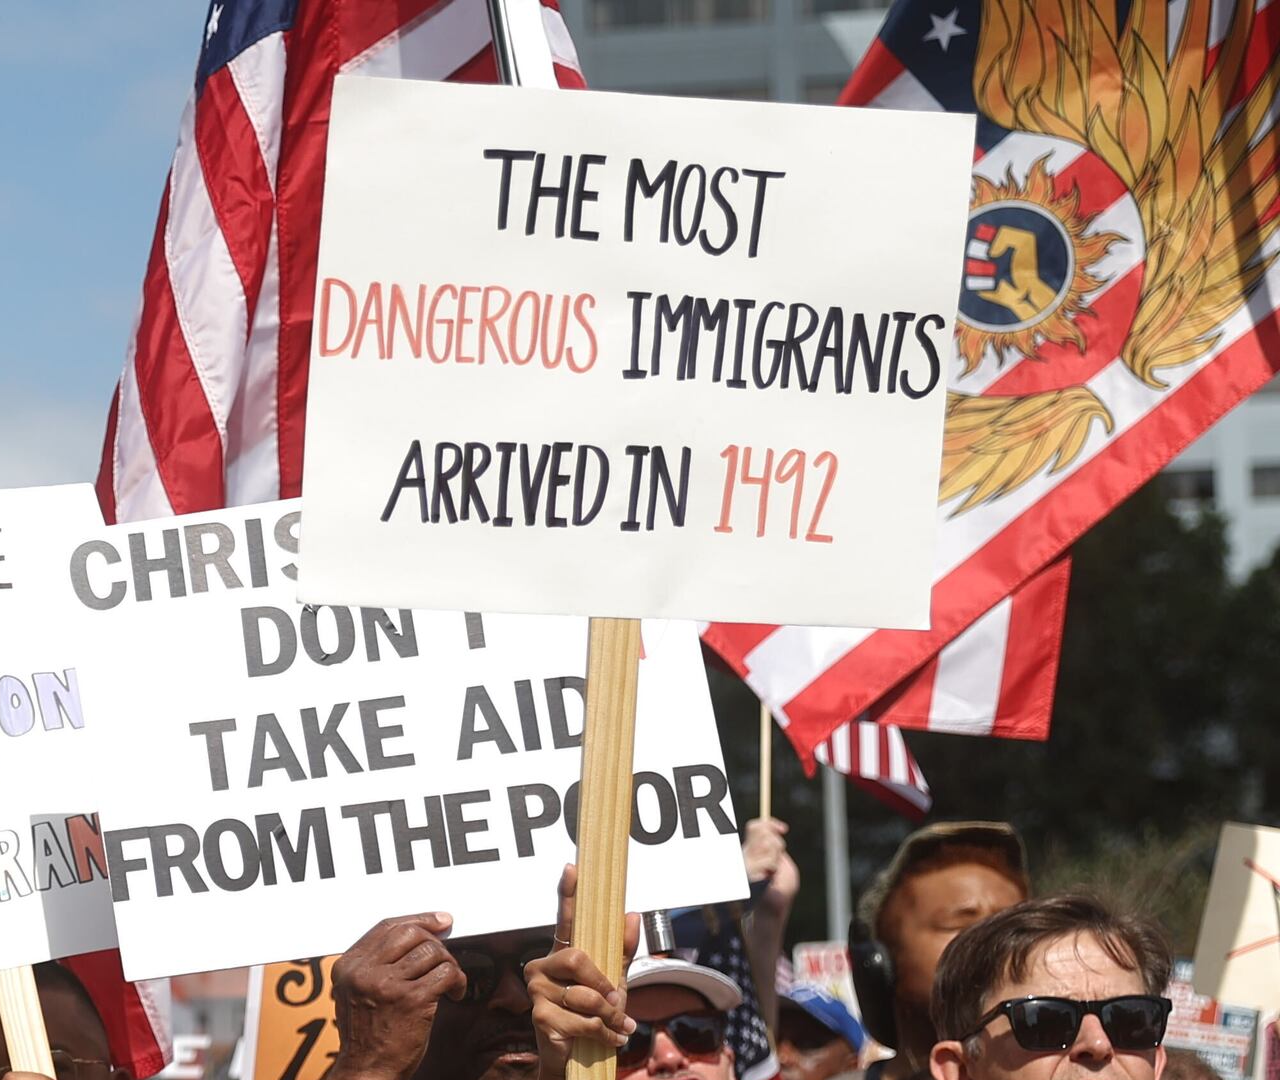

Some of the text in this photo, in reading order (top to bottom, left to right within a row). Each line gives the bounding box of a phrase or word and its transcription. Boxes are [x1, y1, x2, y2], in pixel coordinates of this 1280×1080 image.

[484, 148, 786, 258] THE MOST
[318, 278, 945, 399] DANGEROUS IMMIGRANTS
[380, 439, 839, 544] ARRIVED IN 1492
[189, 694, 416, 792] TAKE
[103, 806, 336, 902] FROM
[341, 789, 500, 875] THE
